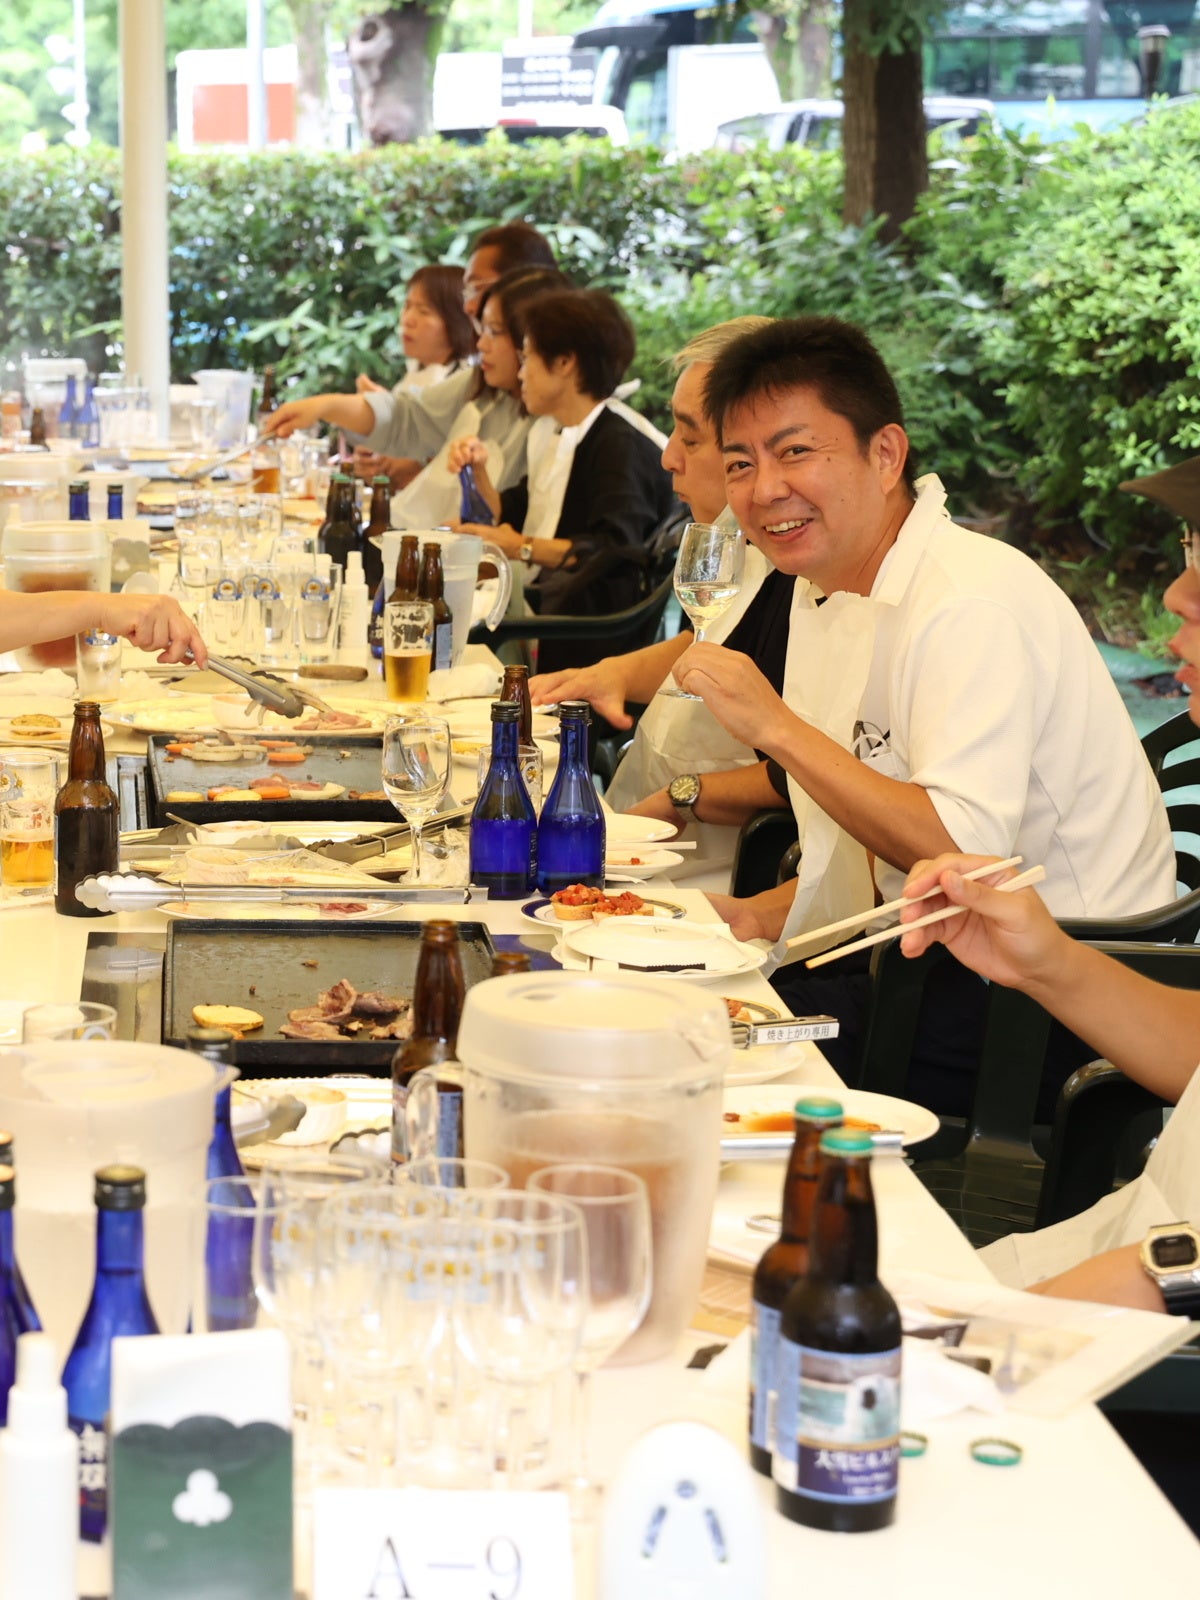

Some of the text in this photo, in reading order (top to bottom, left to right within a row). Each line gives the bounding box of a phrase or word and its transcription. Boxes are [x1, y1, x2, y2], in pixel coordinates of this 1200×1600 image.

[767, 1025, 830, 1041] 焼き上がり専用
[365, 1535, 523, 1600] A-9
